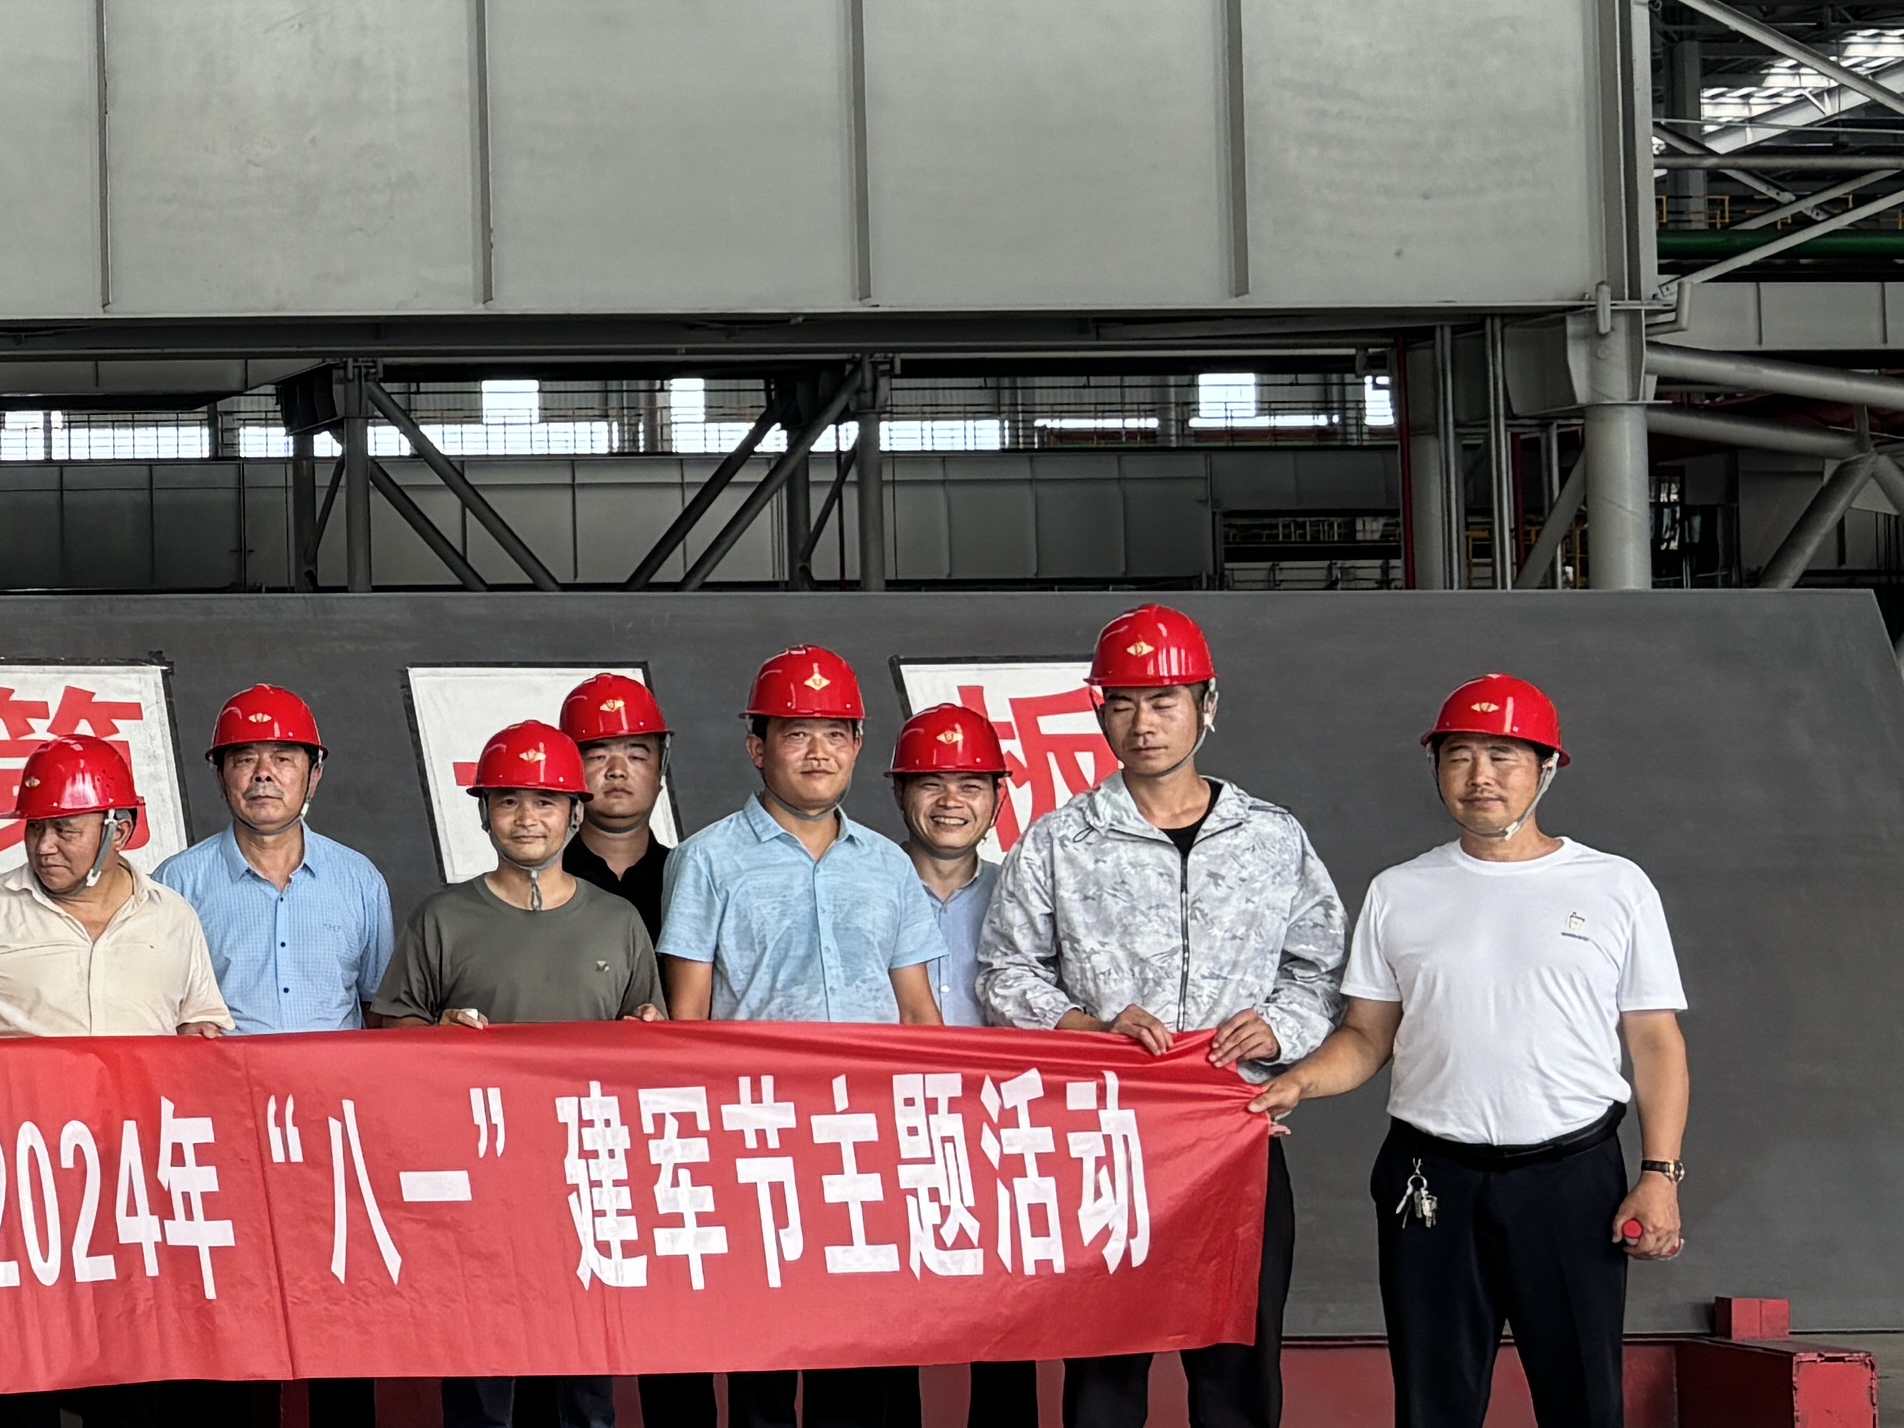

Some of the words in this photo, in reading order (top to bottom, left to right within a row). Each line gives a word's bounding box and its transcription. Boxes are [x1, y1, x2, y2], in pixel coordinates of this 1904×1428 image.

[554, 1068, 1152, 1291] 建军节主题活动
